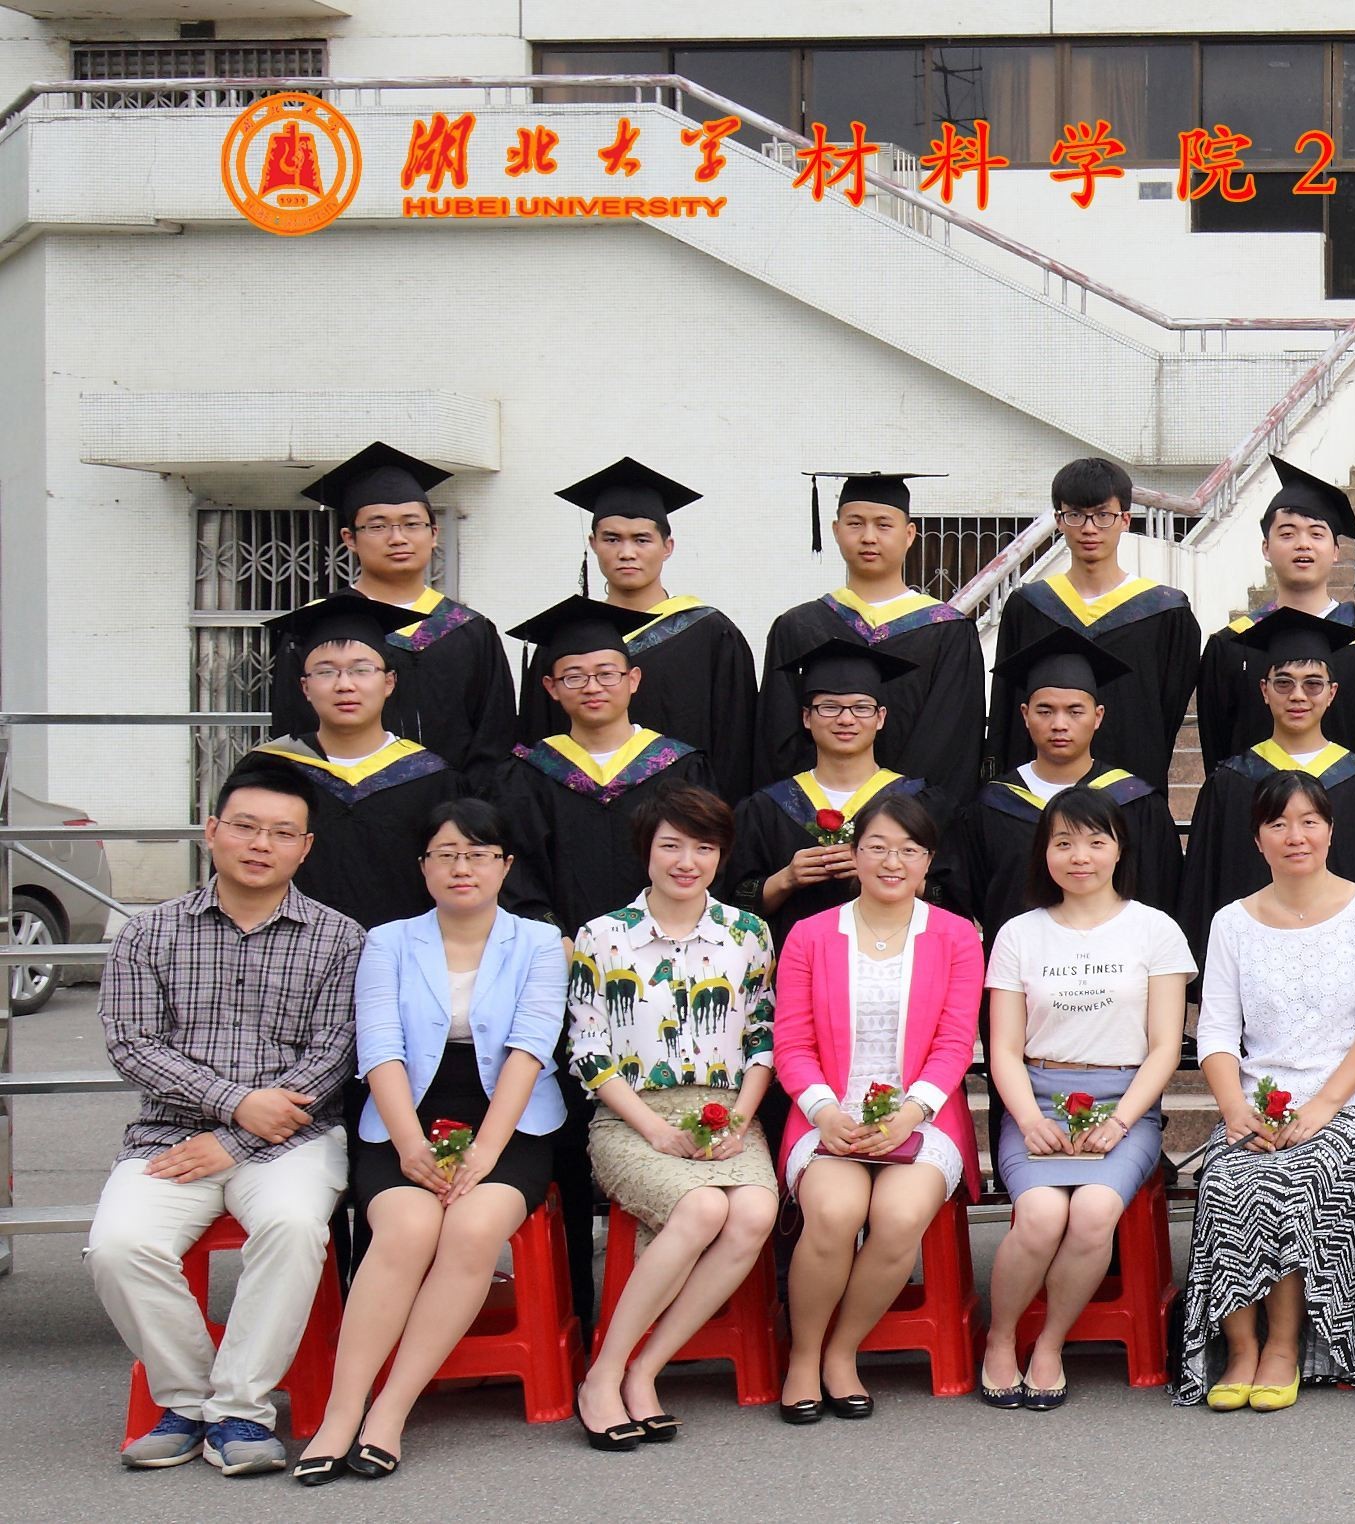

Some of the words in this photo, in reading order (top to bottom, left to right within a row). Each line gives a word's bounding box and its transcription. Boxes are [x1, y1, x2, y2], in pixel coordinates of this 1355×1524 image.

[1042, 966, 1078, 977] FALL'S
[1084, 963, 1125, 975] FINEST
[1058, 989, 1106, 997] STOCKHOLM
[1052, 997, 1114, 1013] WORKWEAR
